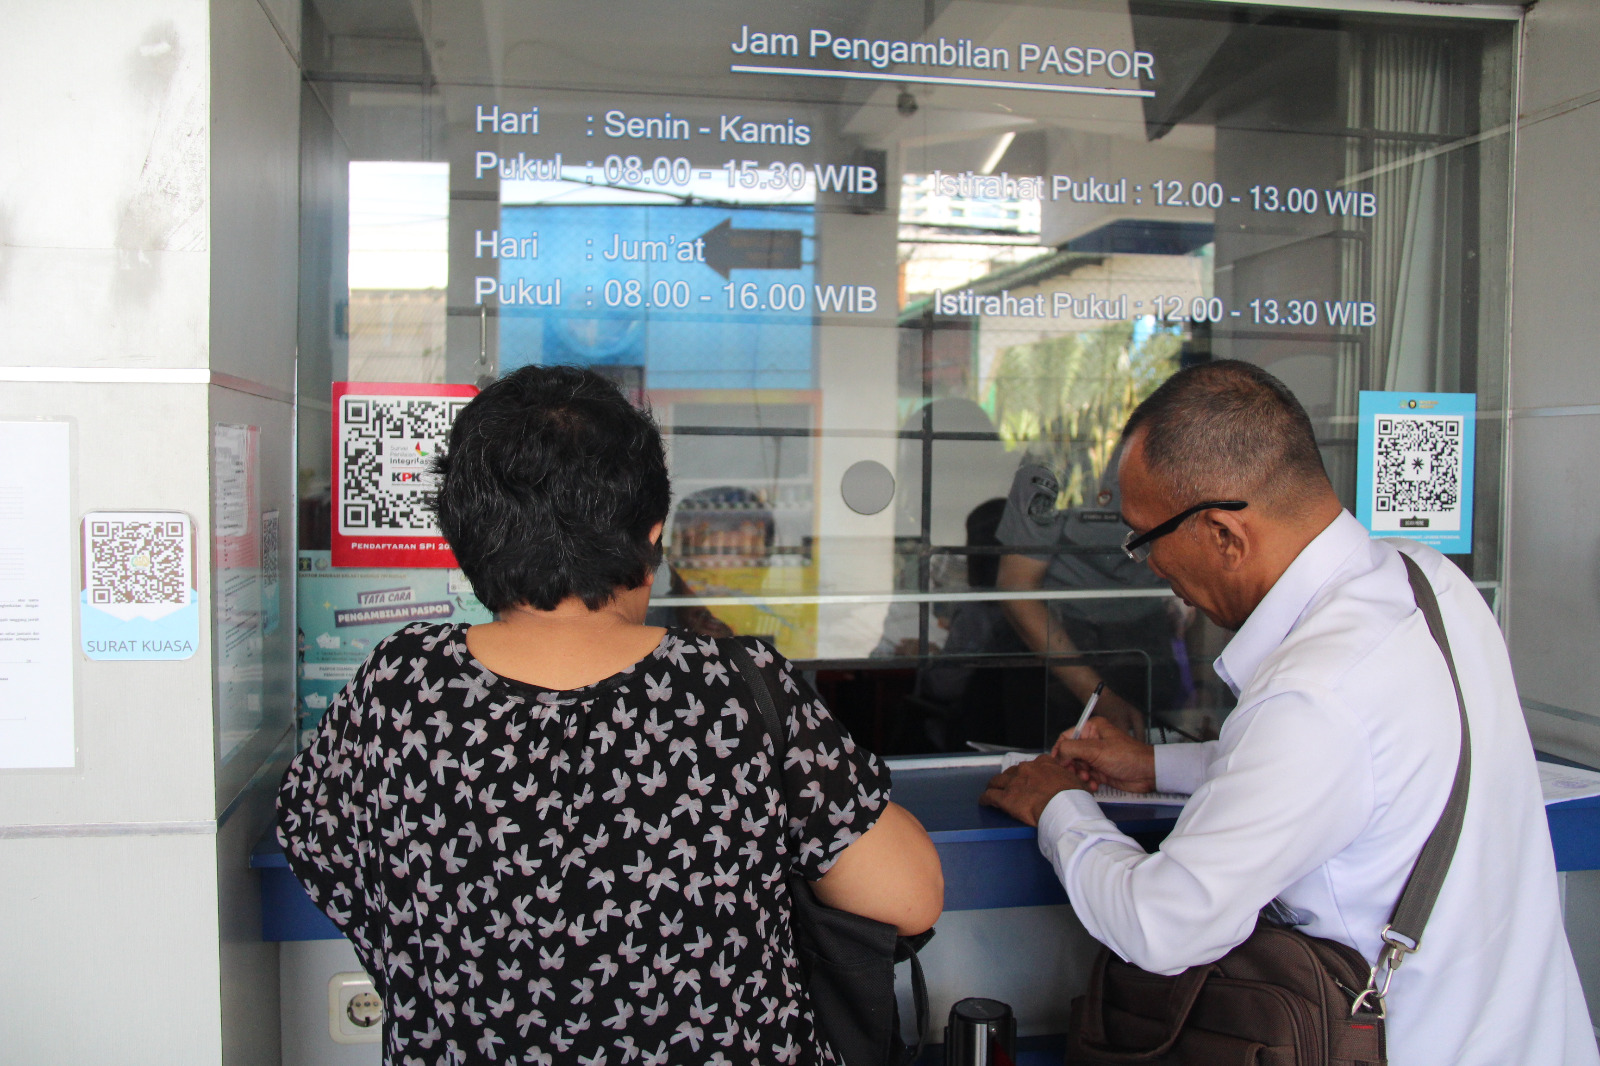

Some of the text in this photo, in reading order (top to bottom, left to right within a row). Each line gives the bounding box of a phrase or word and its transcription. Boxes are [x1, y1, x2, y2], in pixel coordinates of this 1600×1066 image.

[731, 25, 1156, 81] Jam Pengambilan PASPOR
[475, 105, 540, 134] Hari
[604, 110, 691, 140] Senin
[720, 115, 811, 146] Kamis
[475, 151, 562, 182] Pukul
[603, 155, 691, 186] 08.00
[723, 159, 806, 191] 15.30
[814, 163, 878, 194] WIB
[934, 170, 1045, 200] Istirahat
[1051, 174, 1126, 204] Pukul
[1152, 178, 1224, 208] 12.00
[1249, 184, 1318, 214] 13.00
[1325, 190, 1377, 218] WIB
[475, 229, 539, 260] Hari
[475, 276, 561, 306] Pukul
[603, 279, 691, 309] 08.00
[723, 281, 806, 312] 16.00
[814, 284, 877, 313] WIB
[934, 289, 1045, 318] Istirahat
[1052, 292, 1127, 321] Pukul
[1152, 295, 1224, 324] 12.00
[1249, 298, 1318, 326] 13.30
[1325, 301, 1377, 327] WIB
[390, 457, 429, 466] Integritas
[392, 472, 422, 482] KPK
[351, 542, 417, 550] PENDAFTARAN
[419, 542, 436, 550] SPI
[338, 607, 409, 623] PENGAMBILAN
[411, 603, 450, 616] PASPOR
[363, 591, 412, 605] TATA CARA
[87, 640, 193, 653] SURAT KUASA
